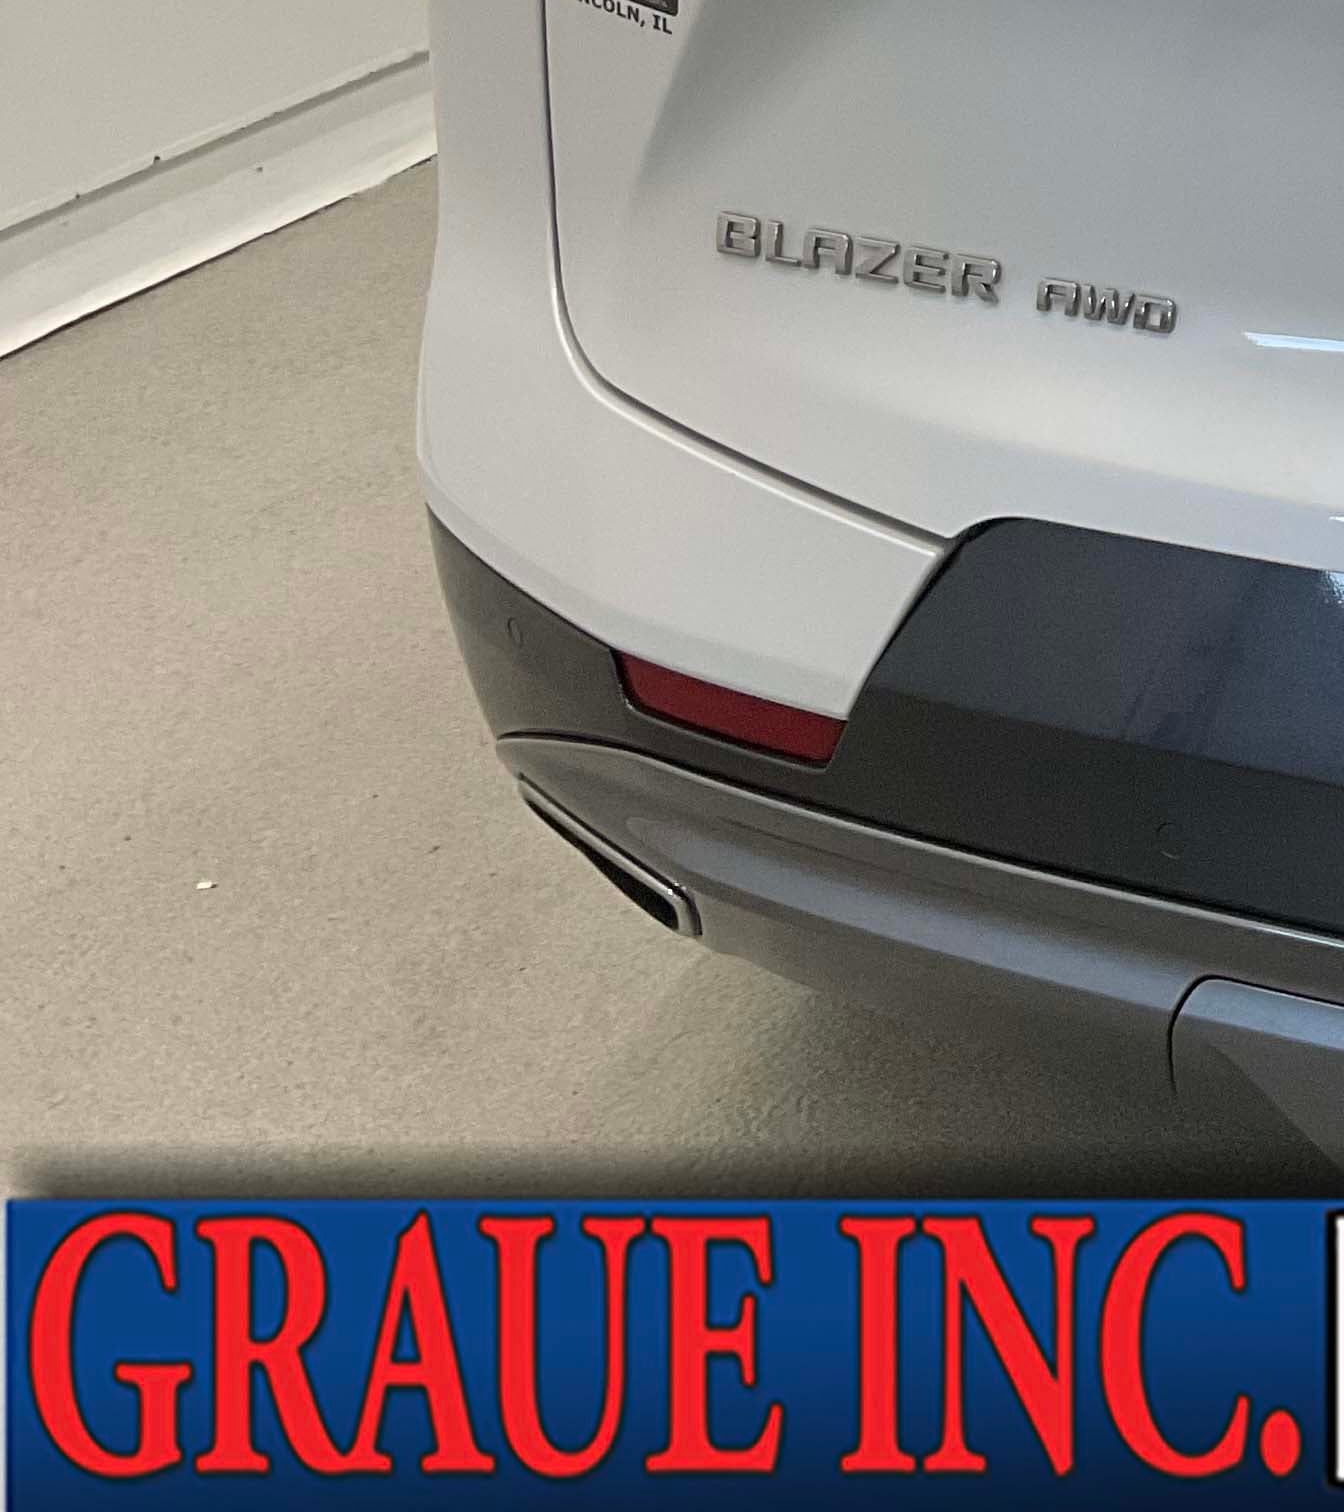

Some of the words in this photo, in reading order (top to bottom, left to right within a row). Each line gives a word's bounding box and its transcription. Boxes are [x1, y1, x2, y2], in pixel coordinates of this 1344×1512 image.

[652, 14, 673, 35] IL
[715, 211, 1001, 304] BLAZER
[1036, 276, 1177, 334] AWD
